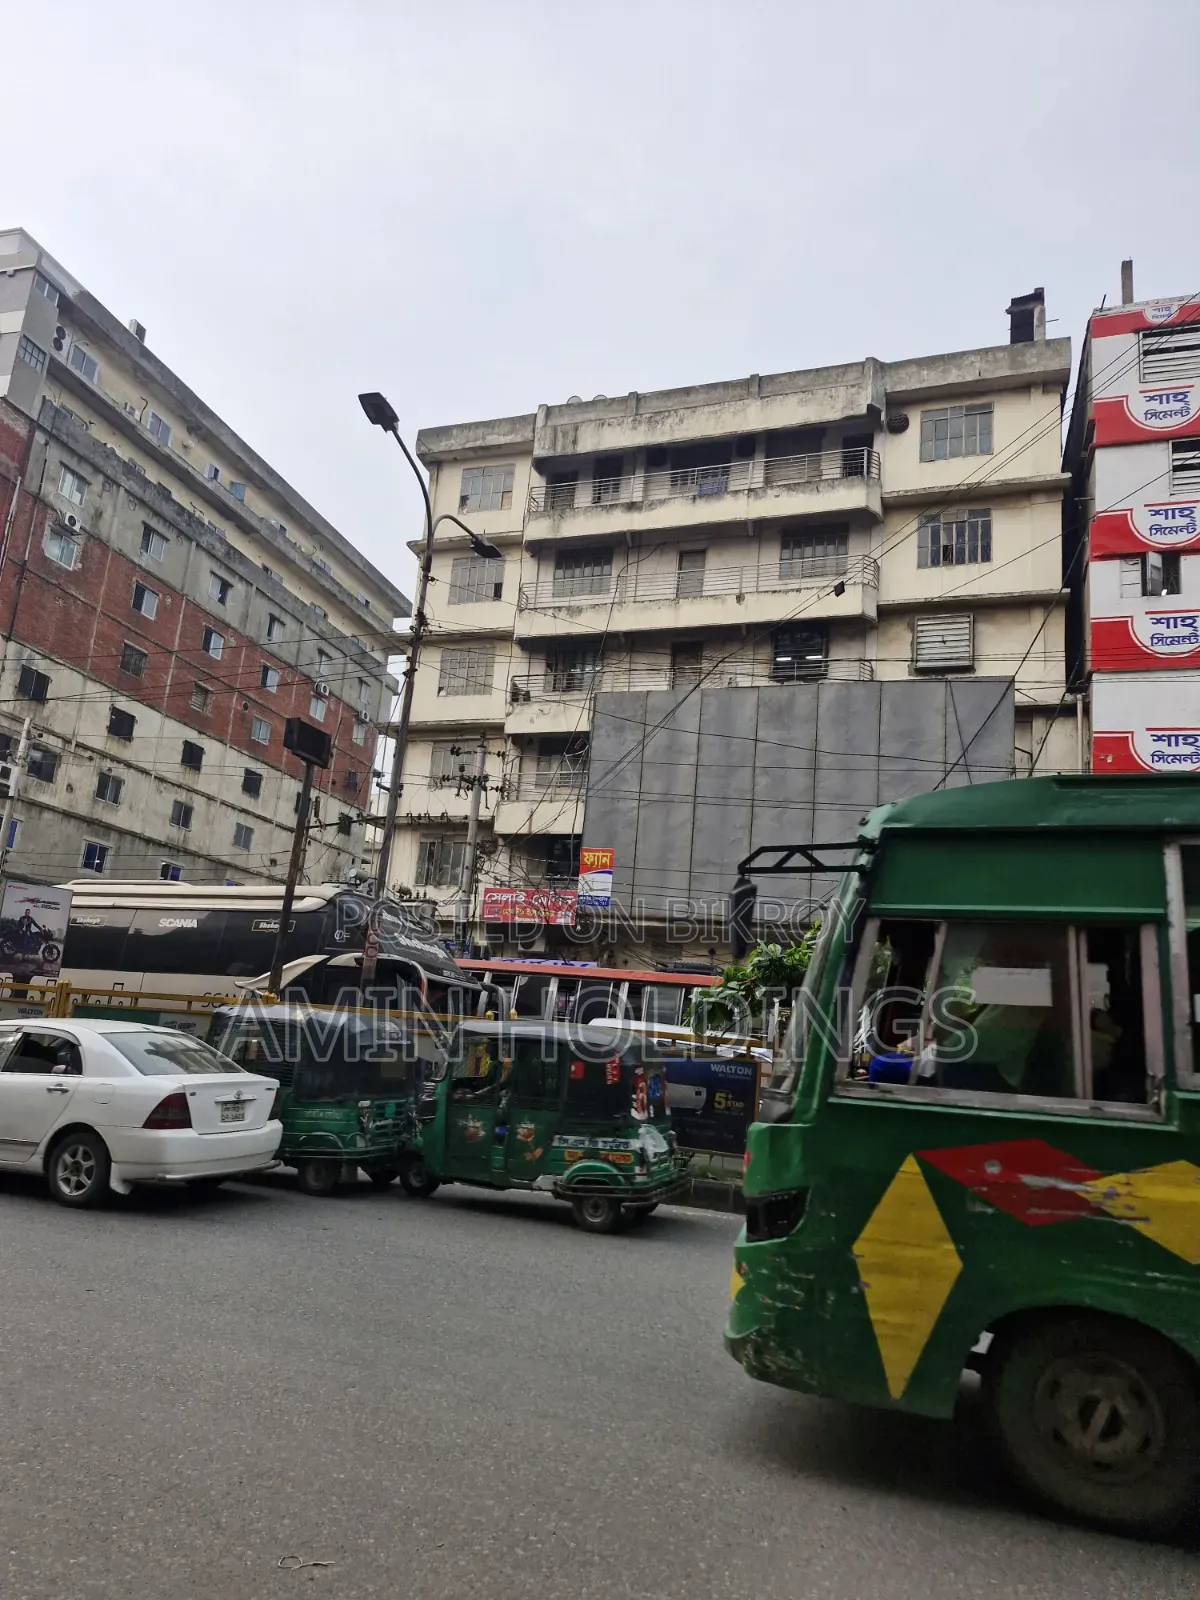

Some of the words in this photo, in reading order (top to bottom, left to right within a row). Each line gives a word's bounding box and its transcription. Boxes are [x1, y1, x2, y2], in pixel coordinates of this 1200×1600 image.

[1144, 406, 1192, 421] সিমেন্ট
[1148, 520, 1197, 537] সিমেন্ট
[1150, 632, 1200, 647] সিমেন্ট
[1150, 750, 1200, 765] সিমেন্ট
[582, 850, 612, 868] ফ্যান
[486, 891, 527, 905] সেলাই
[158, 918, 198, 928] SCANIA
[18, 1007, 43, 1016] WALTON
[710, 1063, 752, 1076] WALTON
